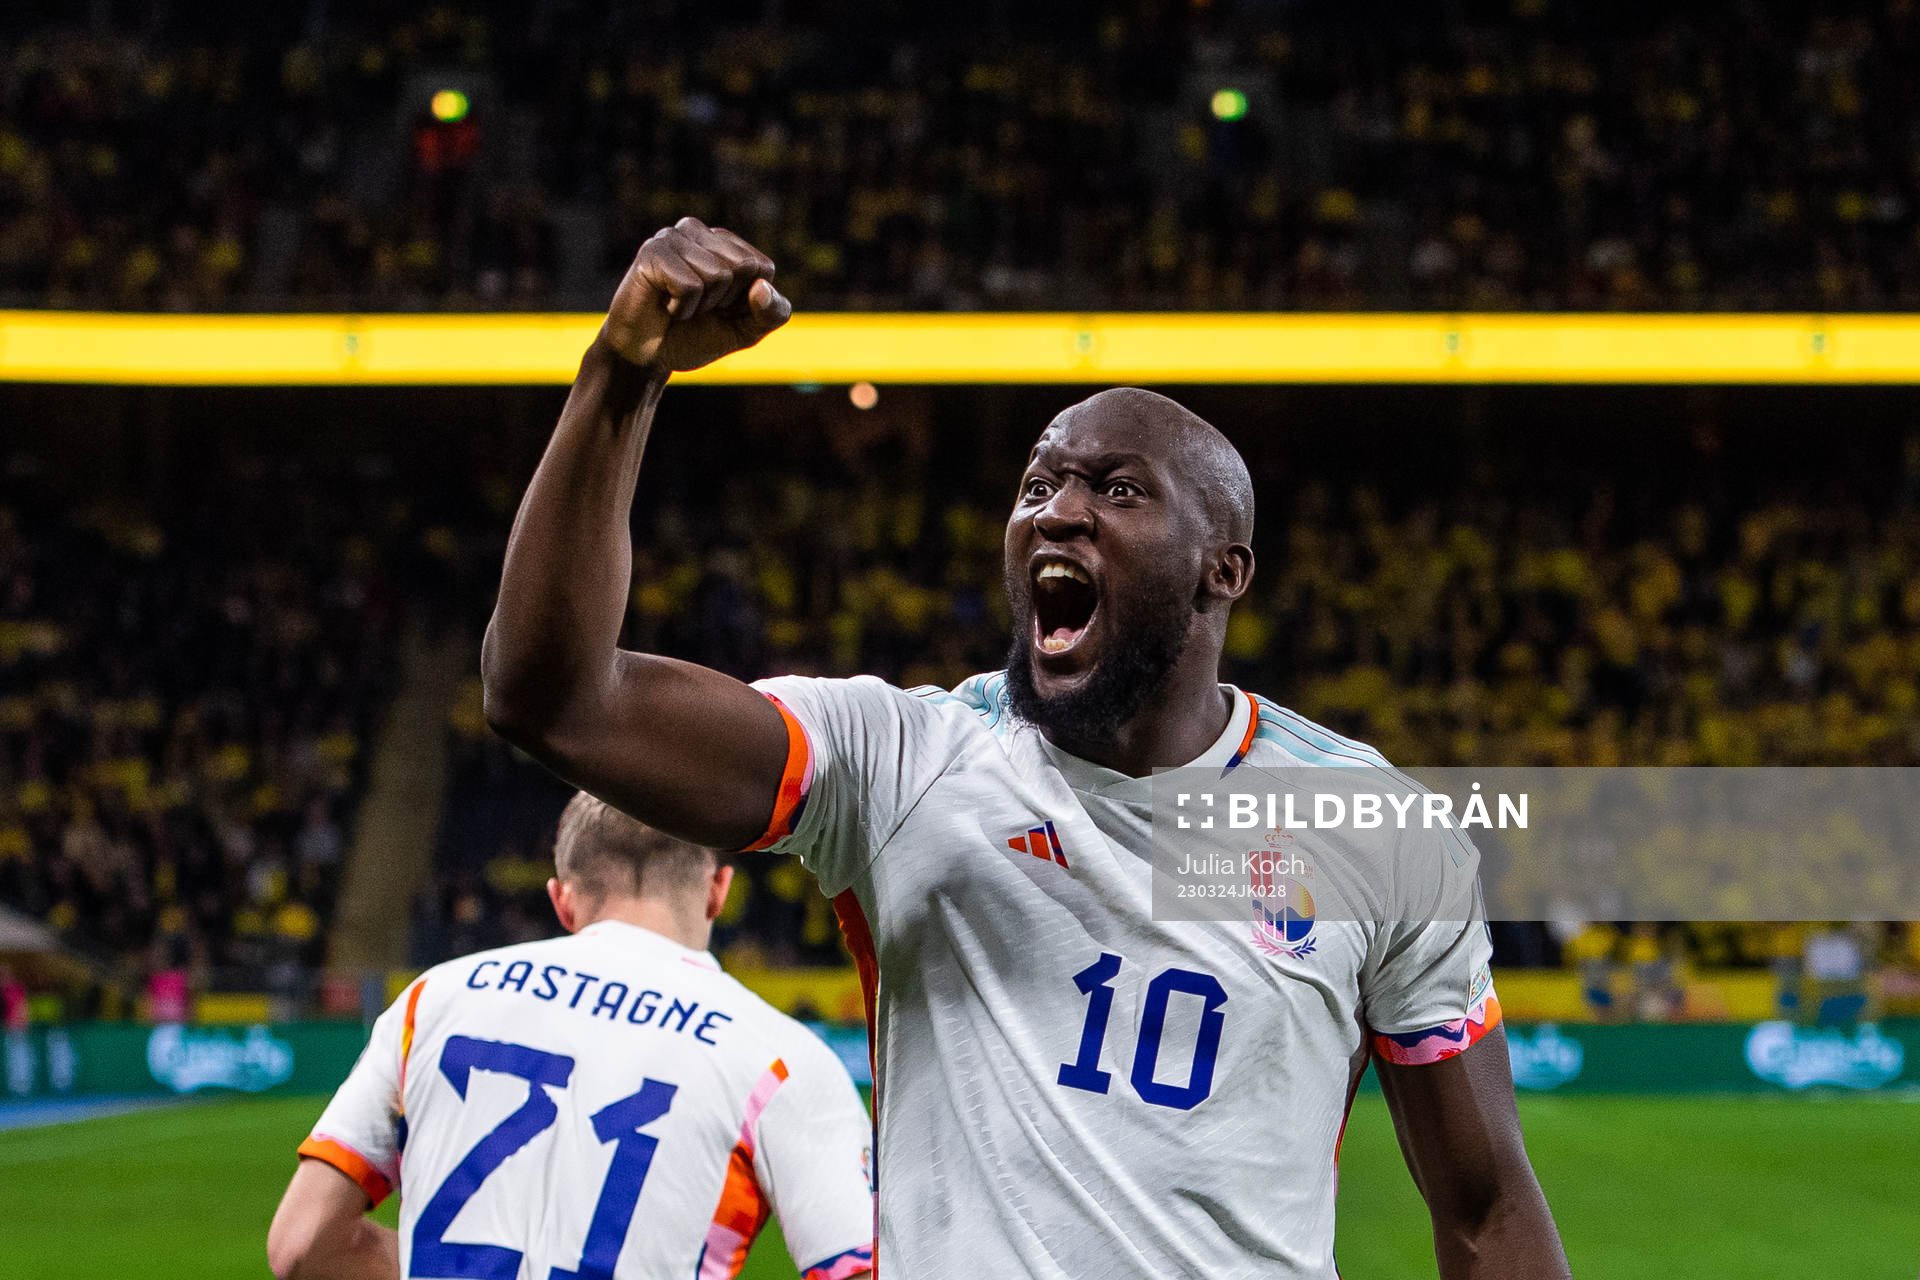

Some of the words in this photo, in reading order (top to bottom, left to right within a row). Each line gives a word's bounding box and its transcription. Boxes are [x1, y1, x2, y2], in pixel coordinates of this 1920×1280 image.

[467, 960, 732, 1046] CASTAGNE
[1057, 952, 1229, 1111] 10
[408, 1034, 679, 1280] 21
